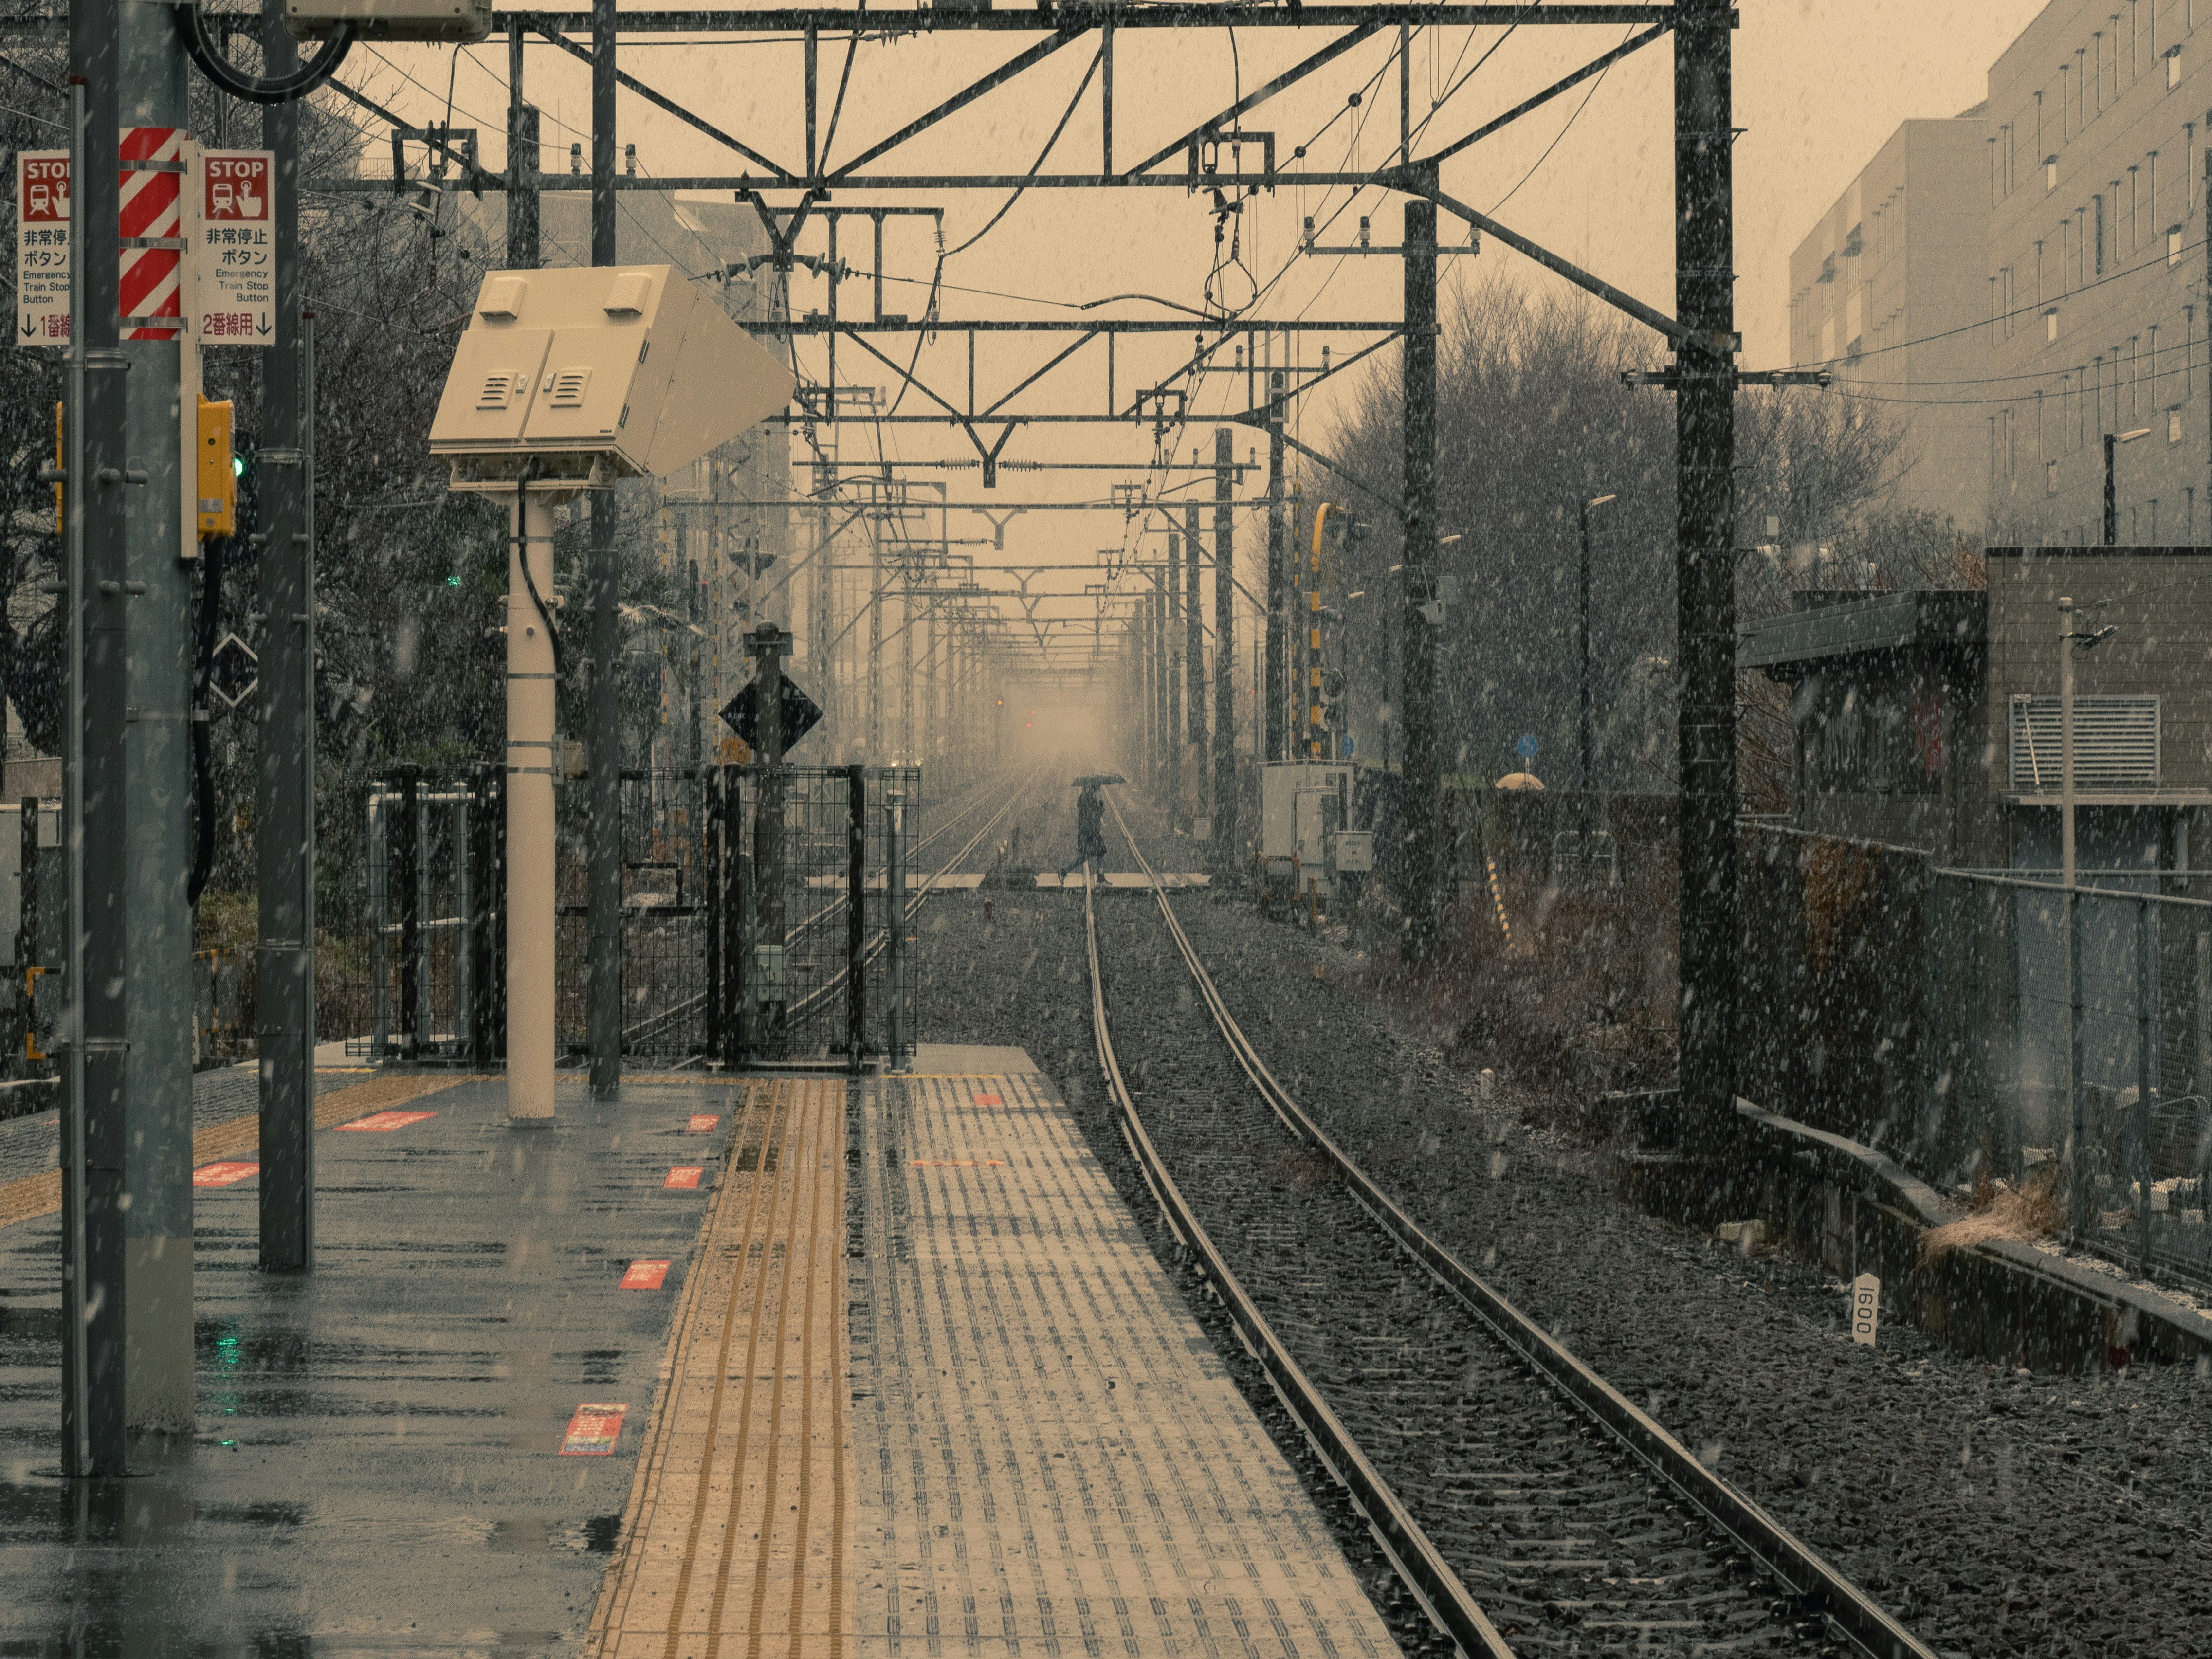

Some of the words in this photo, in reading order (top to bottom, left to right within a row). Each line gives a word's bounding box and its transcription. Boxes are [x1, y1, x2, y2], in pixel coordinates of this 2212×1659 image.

[28, 162, 70, 179] STO
[210, 161, 264, 177] STOP
[24, 229, 70, 246] 非常停
[206, 228, 268, 244] 非常停止
[24, 250, 66, 266] ボタン
[222, 249, 267, 265] ボタン
[216, 269, 269, 278] Emergency
[24, 282, 46, 291] Train
[50, 282, 70, 291] Stop
[219, 281, 243, 290] Train
[247, 281, 269, 290] Stop
[23, 295, 53, 303] Button
[237, 293, 269, 302] Button
[203, 312, 253, 336] 2番線用
[1856, 1287, 1875, 1333] 1600
